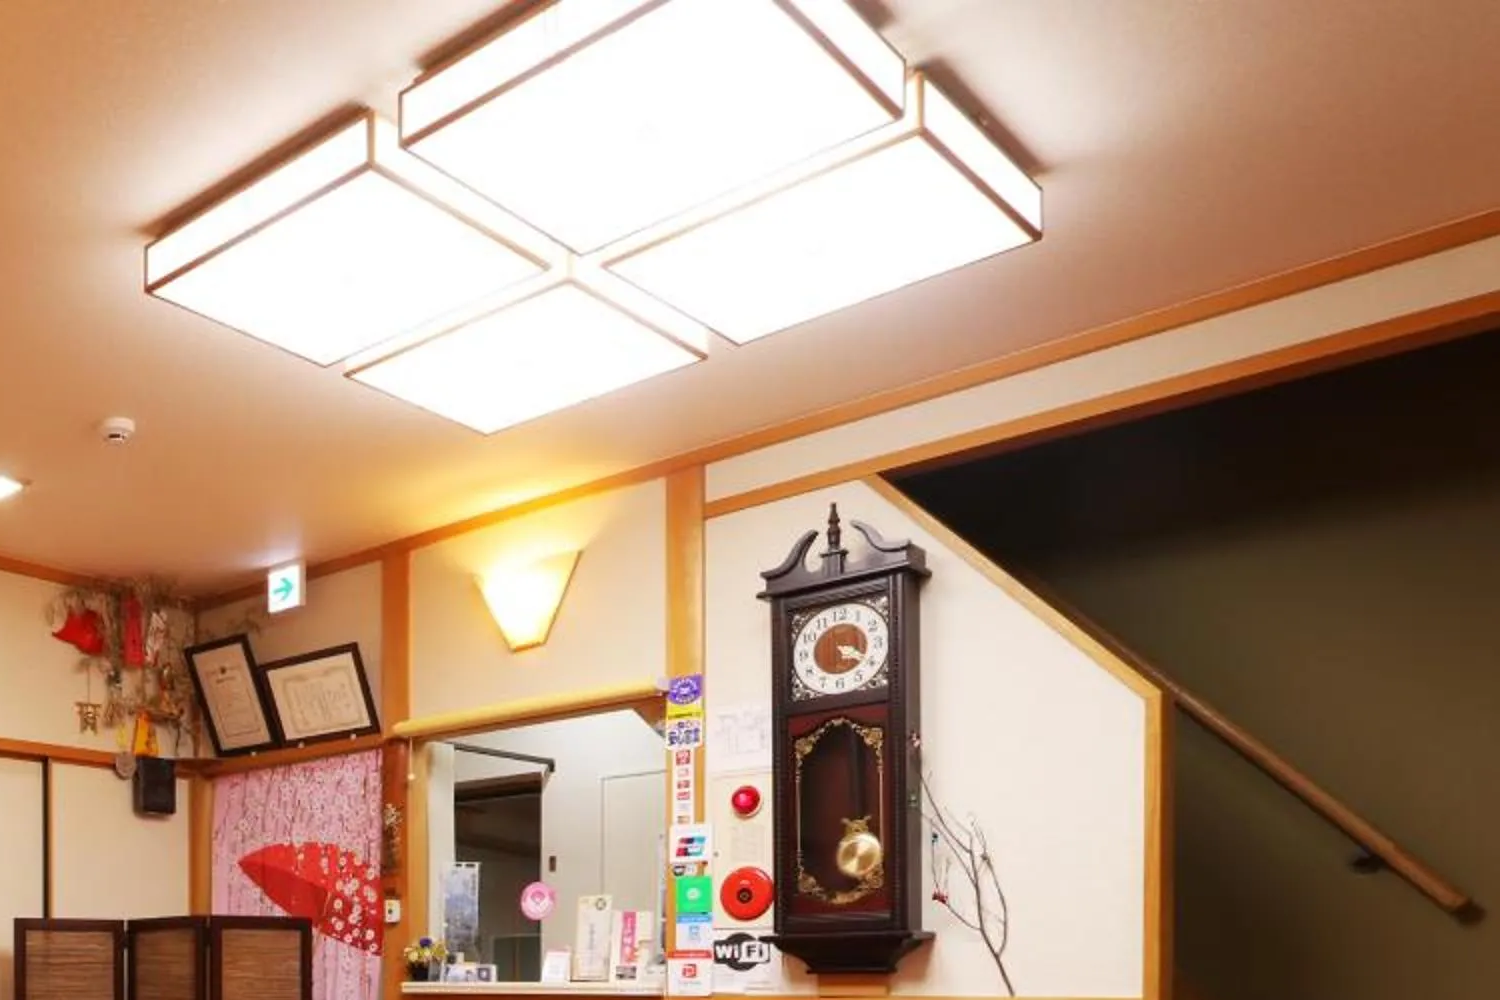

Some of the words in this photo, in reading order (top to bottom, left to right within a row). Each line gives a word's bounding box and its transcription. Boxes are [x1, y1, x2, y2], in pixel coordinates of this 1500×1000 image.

[833, 607, 847, 622] 12
[817, 617, 827, 630] 11
[868, 619, 878, 632] 2
[803, 630, 817, 643] 10
[874, 636, 883, 648] 3
[854, 669, 864, 681] 5
[819, 676, 827, 689] 7
[835, 677, 845, 689] 6
